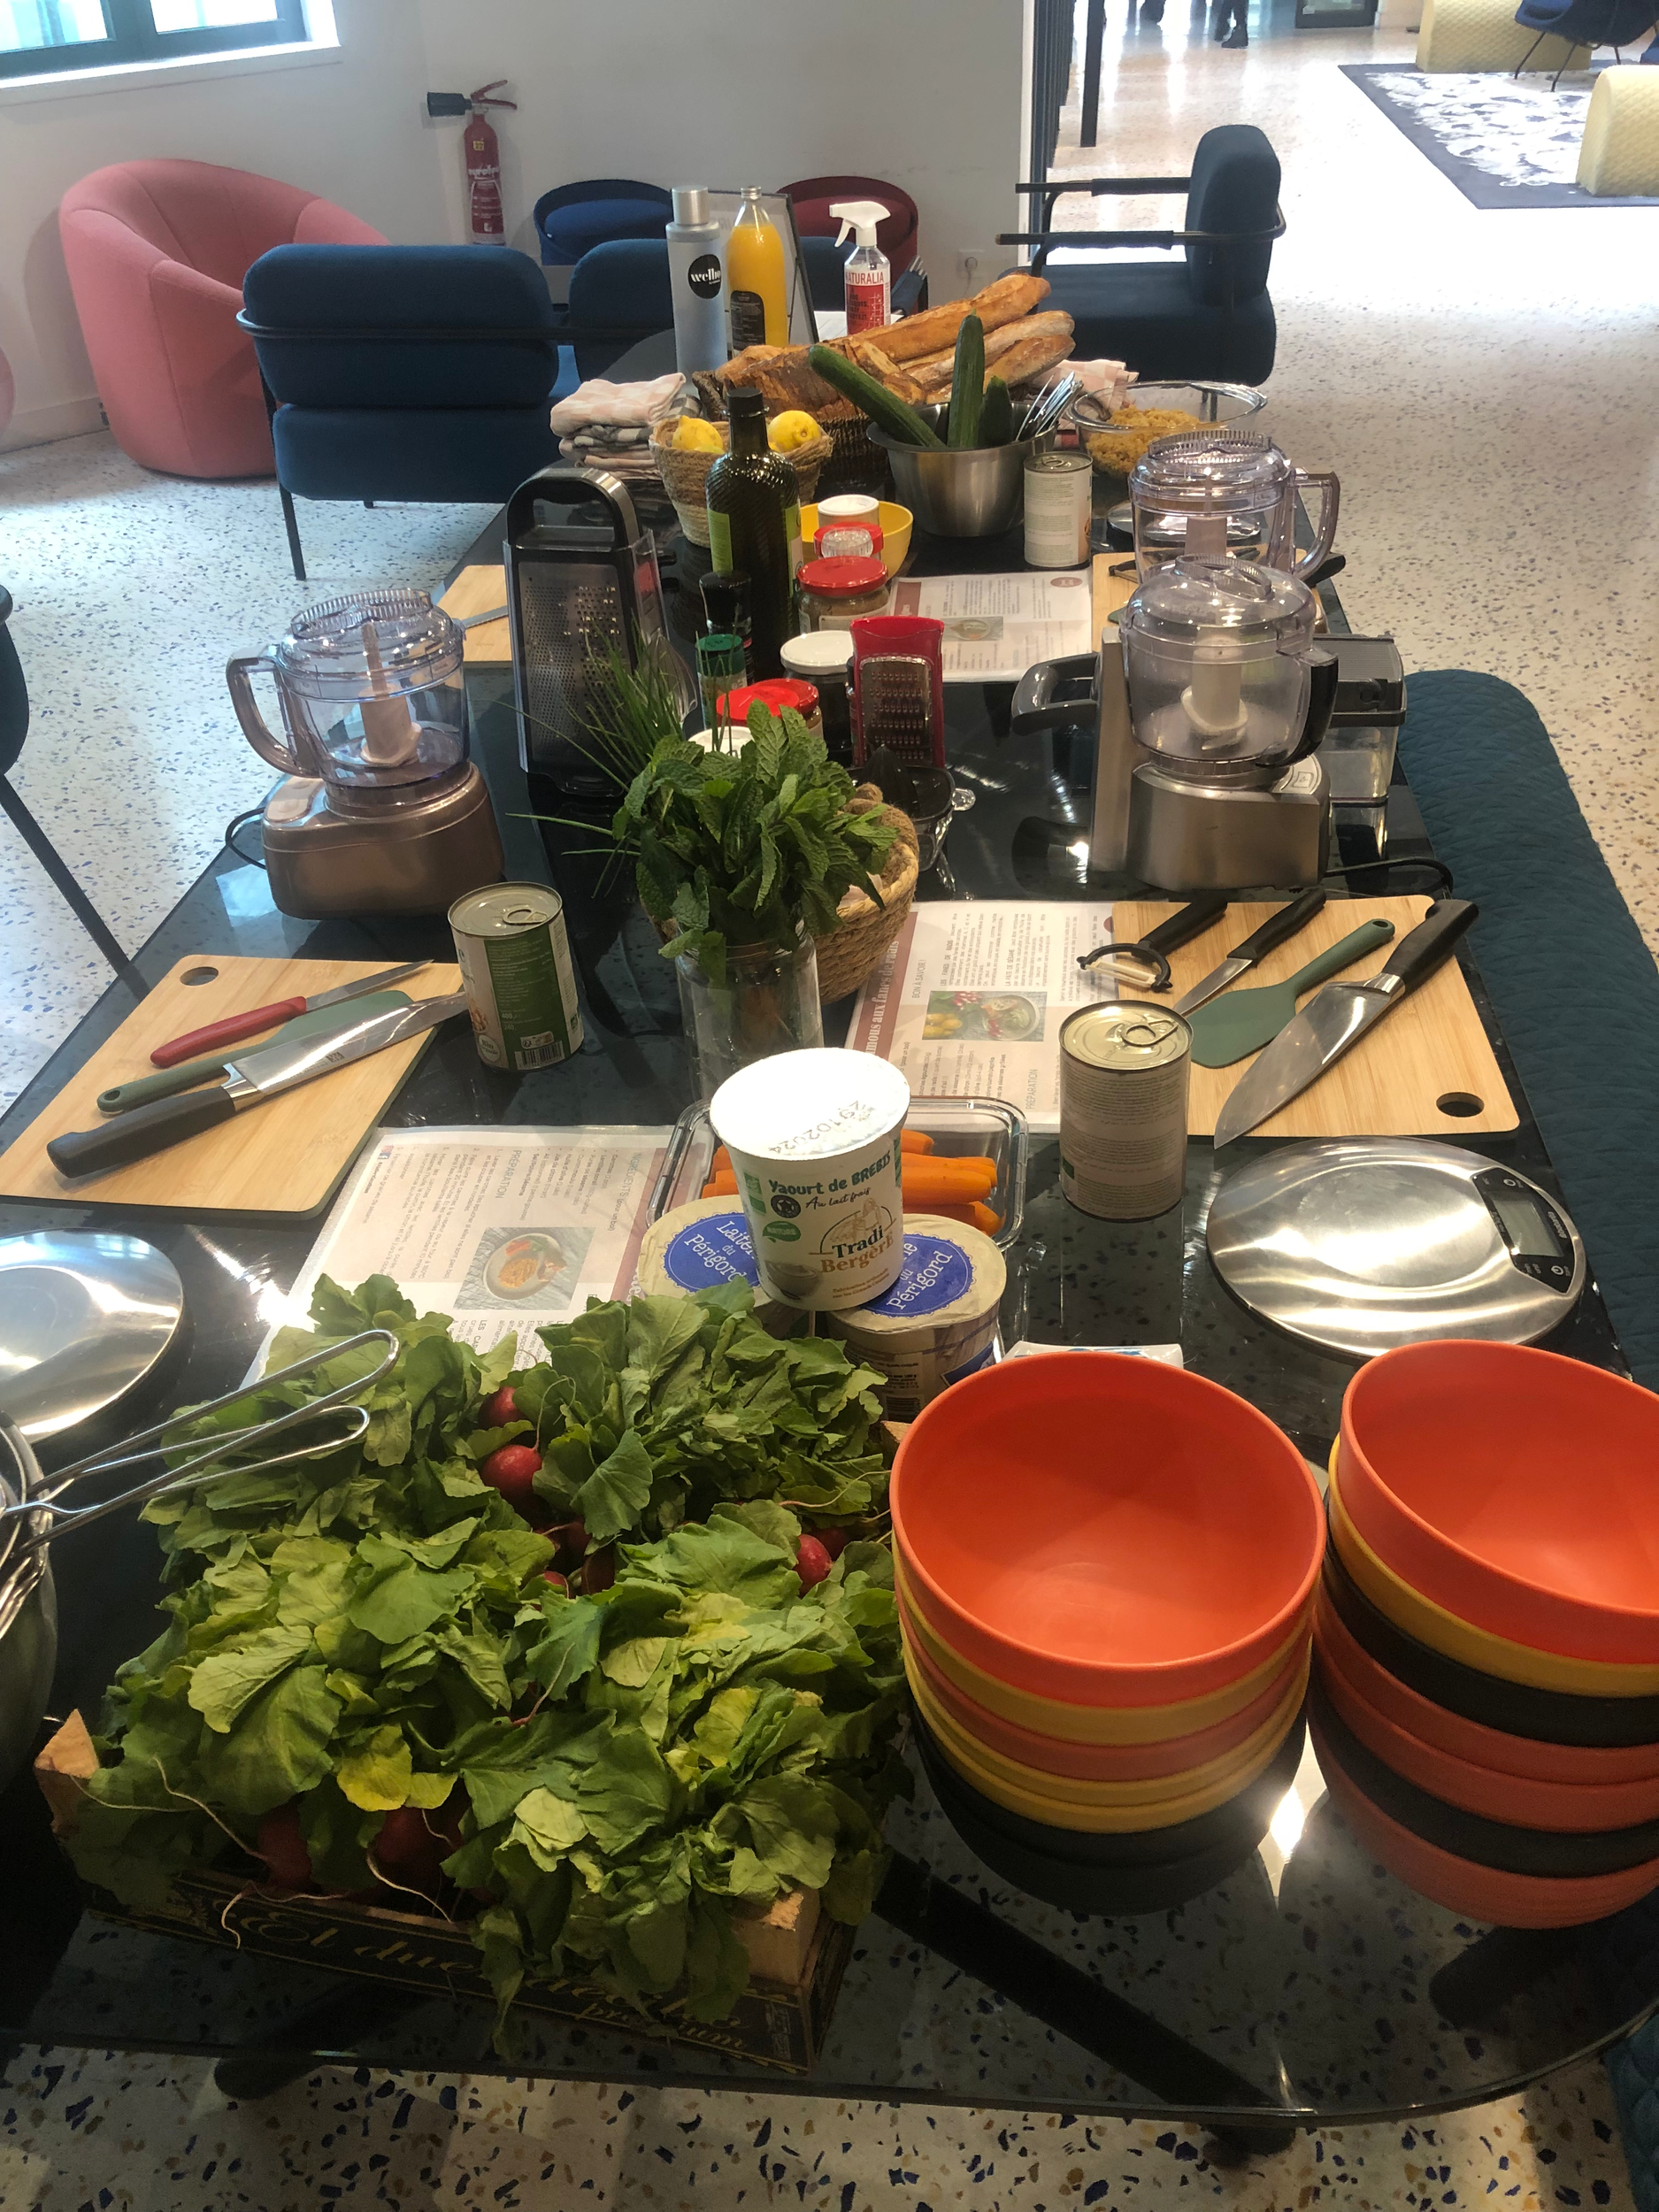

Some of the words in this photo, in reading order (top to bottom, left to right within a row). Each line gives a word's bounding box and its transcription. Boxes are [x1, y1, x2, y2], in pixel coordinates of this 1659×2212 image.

[846, 272, 884, 284] NATURALIA
[879, 965, 895, 975] de
[915, 963, 926, 980] SAVOIR
[872, 978, 891, 1002] fanes
[912, 987, 921, 998] BON
[872, 1005, 885, 1022] aux
[865, 1025, 880, 1052] mous
[1025, 1070, 1037, 1109] PRÉPARATION
[496, 1150, 521, 1198] PRÉPARATION
[769, 1179, 825, 1195] Yaourt
[828, 1179, 848, 1192] de
[851, 1149, 891, 1187] BREBIS
[805, 1197, 826, 1210] Au
[829, 1194, 849, 1207] lait
[849, 1187, 872, 1202] frais
[722, 1245, 736, 1256] du
[832, 1225, 884, 1258] Tradi
[684, 1233, 747, 1282] Périgord
[886, 1250, 953, 1310] Périgord
